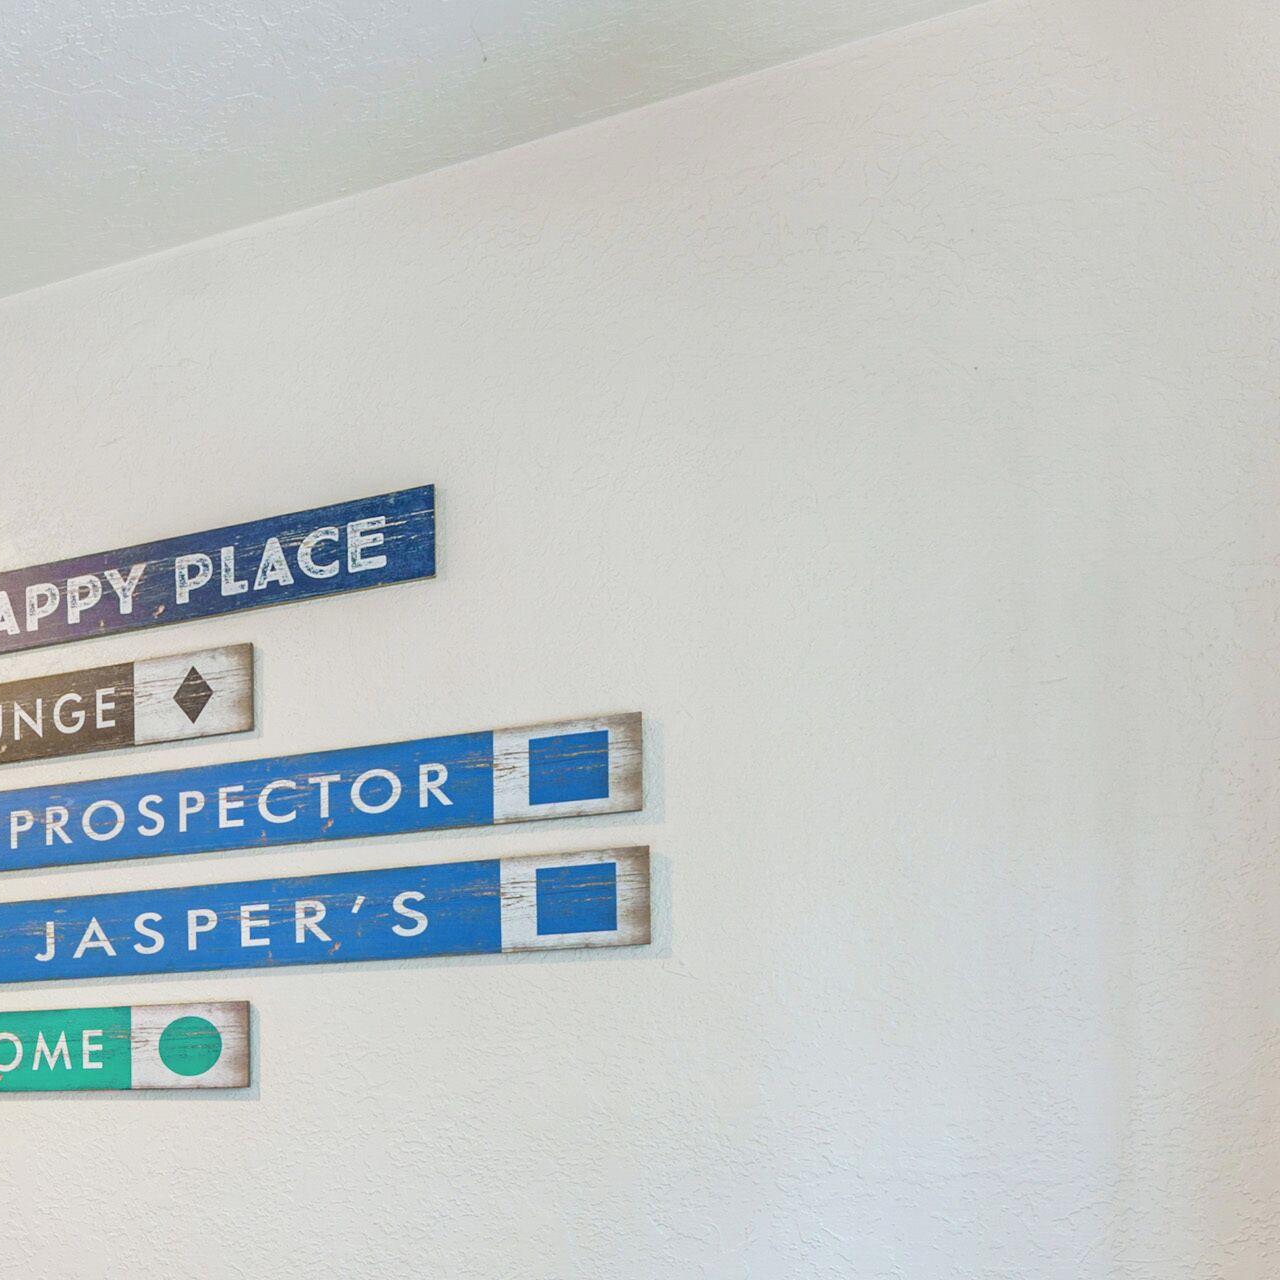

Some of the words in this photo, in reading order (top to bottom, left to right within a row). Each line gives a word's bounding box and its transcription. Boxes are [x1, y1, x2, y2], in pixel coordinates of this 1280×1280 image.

[175, 516, 387, 605] PLACE
[9, 762, 454, 850] PROSPECTOR
[34, 891, 429, 964] JASPER'S
